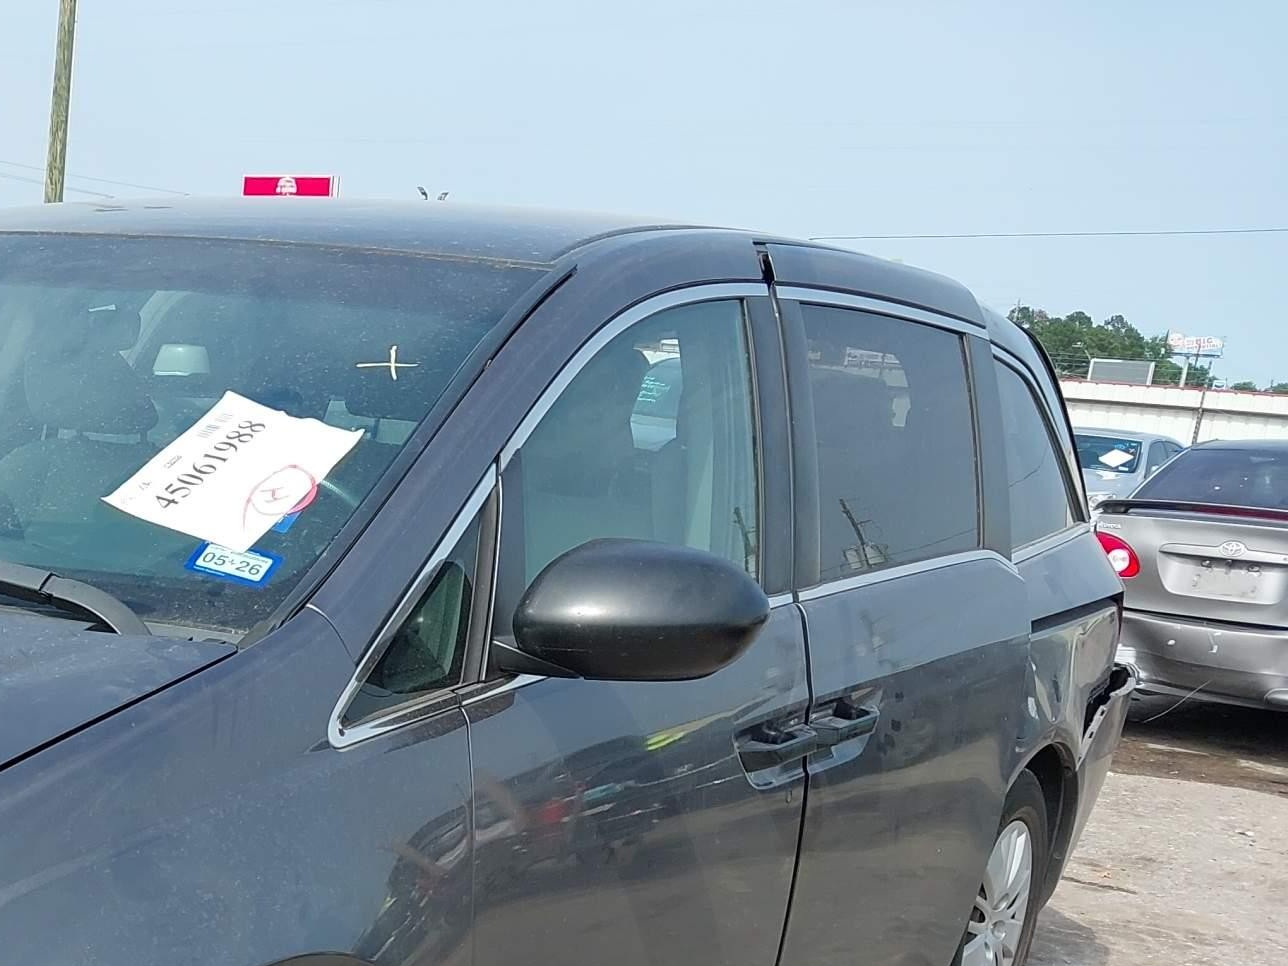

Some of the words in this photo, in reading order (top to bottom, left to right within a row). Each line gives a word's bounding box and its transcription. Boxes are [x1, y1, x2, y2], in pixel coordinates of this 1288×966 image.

[156, 420, 266, 509] 45061988
[202, 552, 229, 566] 05
[235, 560, 262, 576] 26
